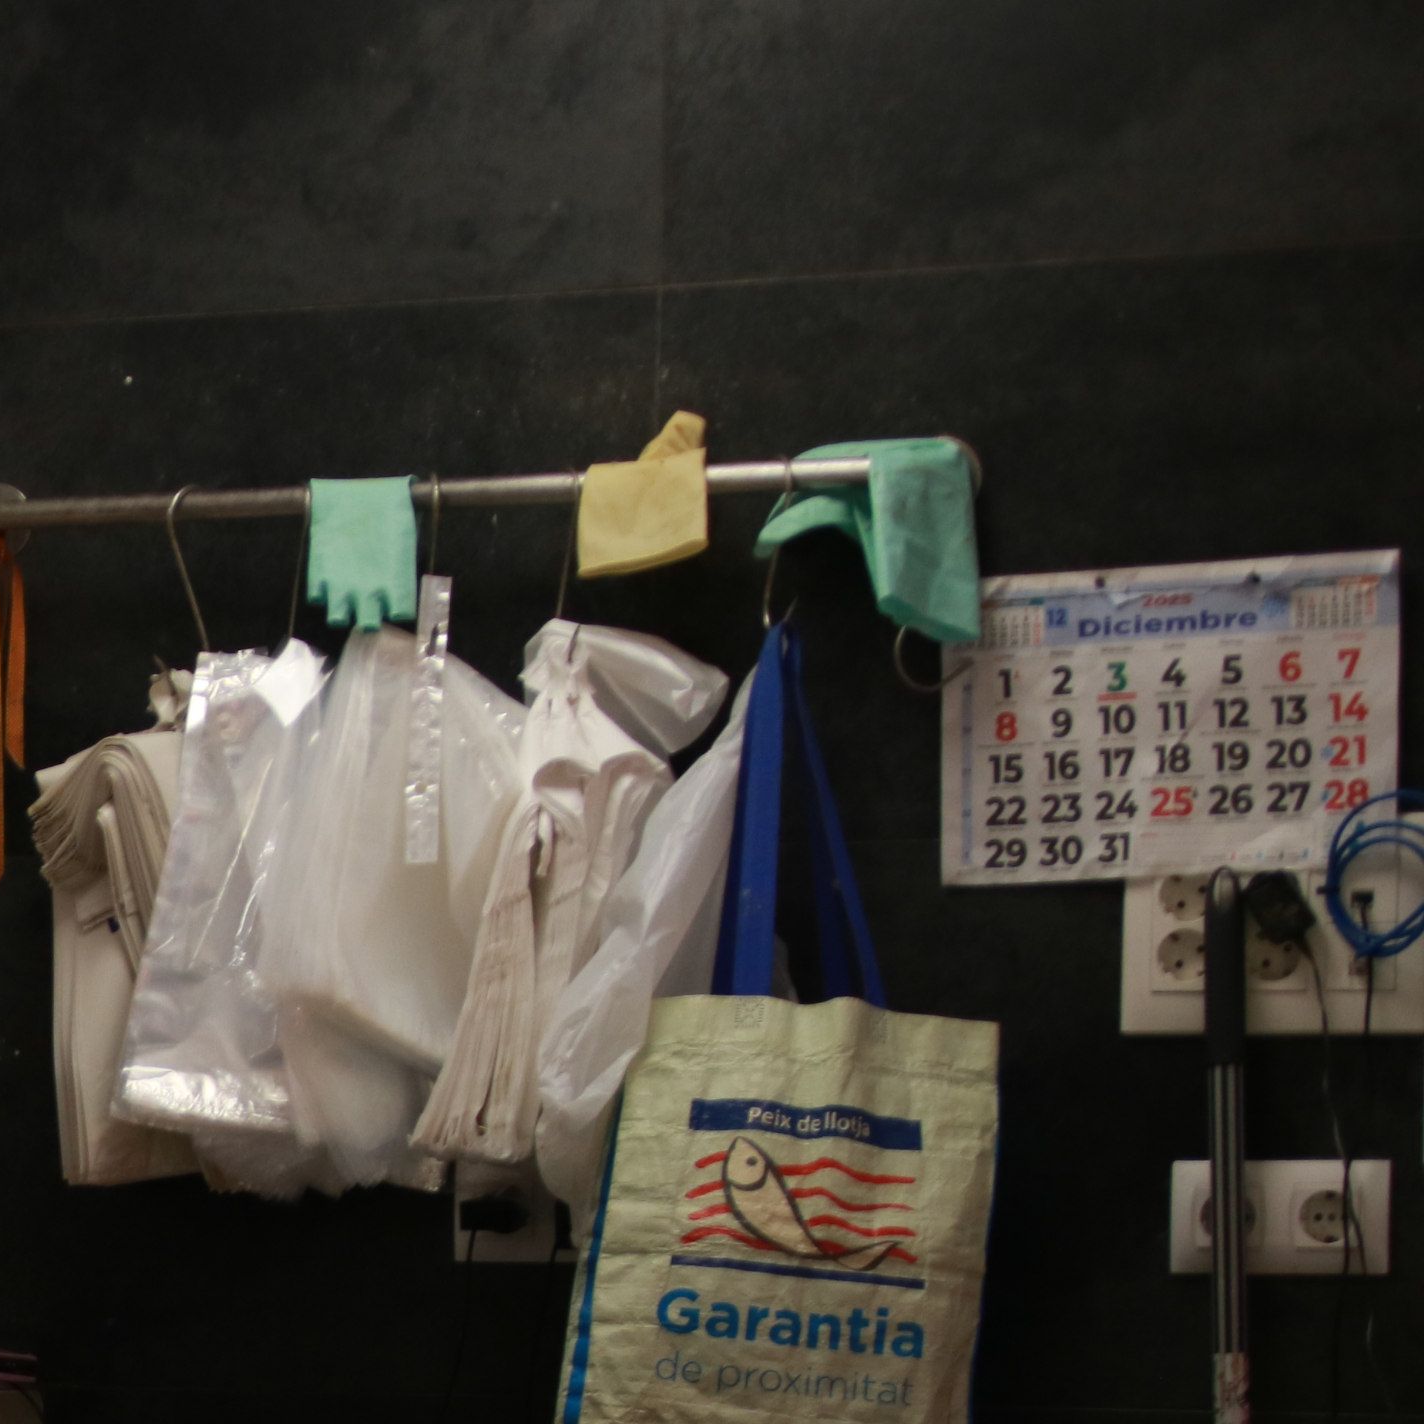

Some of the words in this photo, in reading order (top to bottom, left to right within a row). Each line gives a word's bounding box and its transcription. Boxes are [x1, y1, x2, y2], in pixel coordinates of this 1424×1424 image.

[1047, 609, 1066, 627] 12
[1077, 608, 1258, 638] Diciembre
[998, 668, 1012, 698] 1
[1052, 665, 1072, 695] 2
[1106, 661, 1128, 691] 3
[1161, 657, 1187, 687] 4
[1220, 653, 1243, 684] 5
[1278, 651, 1301, 682] 6
[1338, 647, 1361, 678] 7
[995, 711, 1018, 742] 8
[1051, 707, 1072, 738] 9
[1099, 704, 1136, 735] 10
[1157, 700, 1187, 731] 11
[1213, 698, 1250, 728] 12
[1270, 694, 1307, 725] 13
[1328, 692, 1369, 723] 14
[988, 753, 1024, 784] 15
[1044, 750, 1081, 781] 16
[1099, 747, 1135, 777] 17
[1155, 743, 1191, 774] 18
[1212, 741, 1250, 771] 19
[1265, 738, 1313, 769] 20
[1328, 735, 1367, 766] 21
[985, 796, 1027, 827] 22
[1041, 793, 1082, 824] 23
[1095, 790, 1138, 821] 24
[1150, 786, 1194, 818] 25
[1208, 784, 1253, 815] 26
[1266, 781, 1311, 812] 27
[1324, 777, 1370, 811] 28
[984, 838, 1028, 868] 29
[1039, 834, 1083, 866] 30
[1098, 832, 1130, 862] 31
[747, 1106, 791, 1129] Peix
[797, 1110, 821, 1134] de
[824, 1110, 871, 1138] llotja
[656, 1287, 925, 1359] Garantia
[655, 1351, 703, 1384] de
[716, 1363, 914, 1408] proximitat
